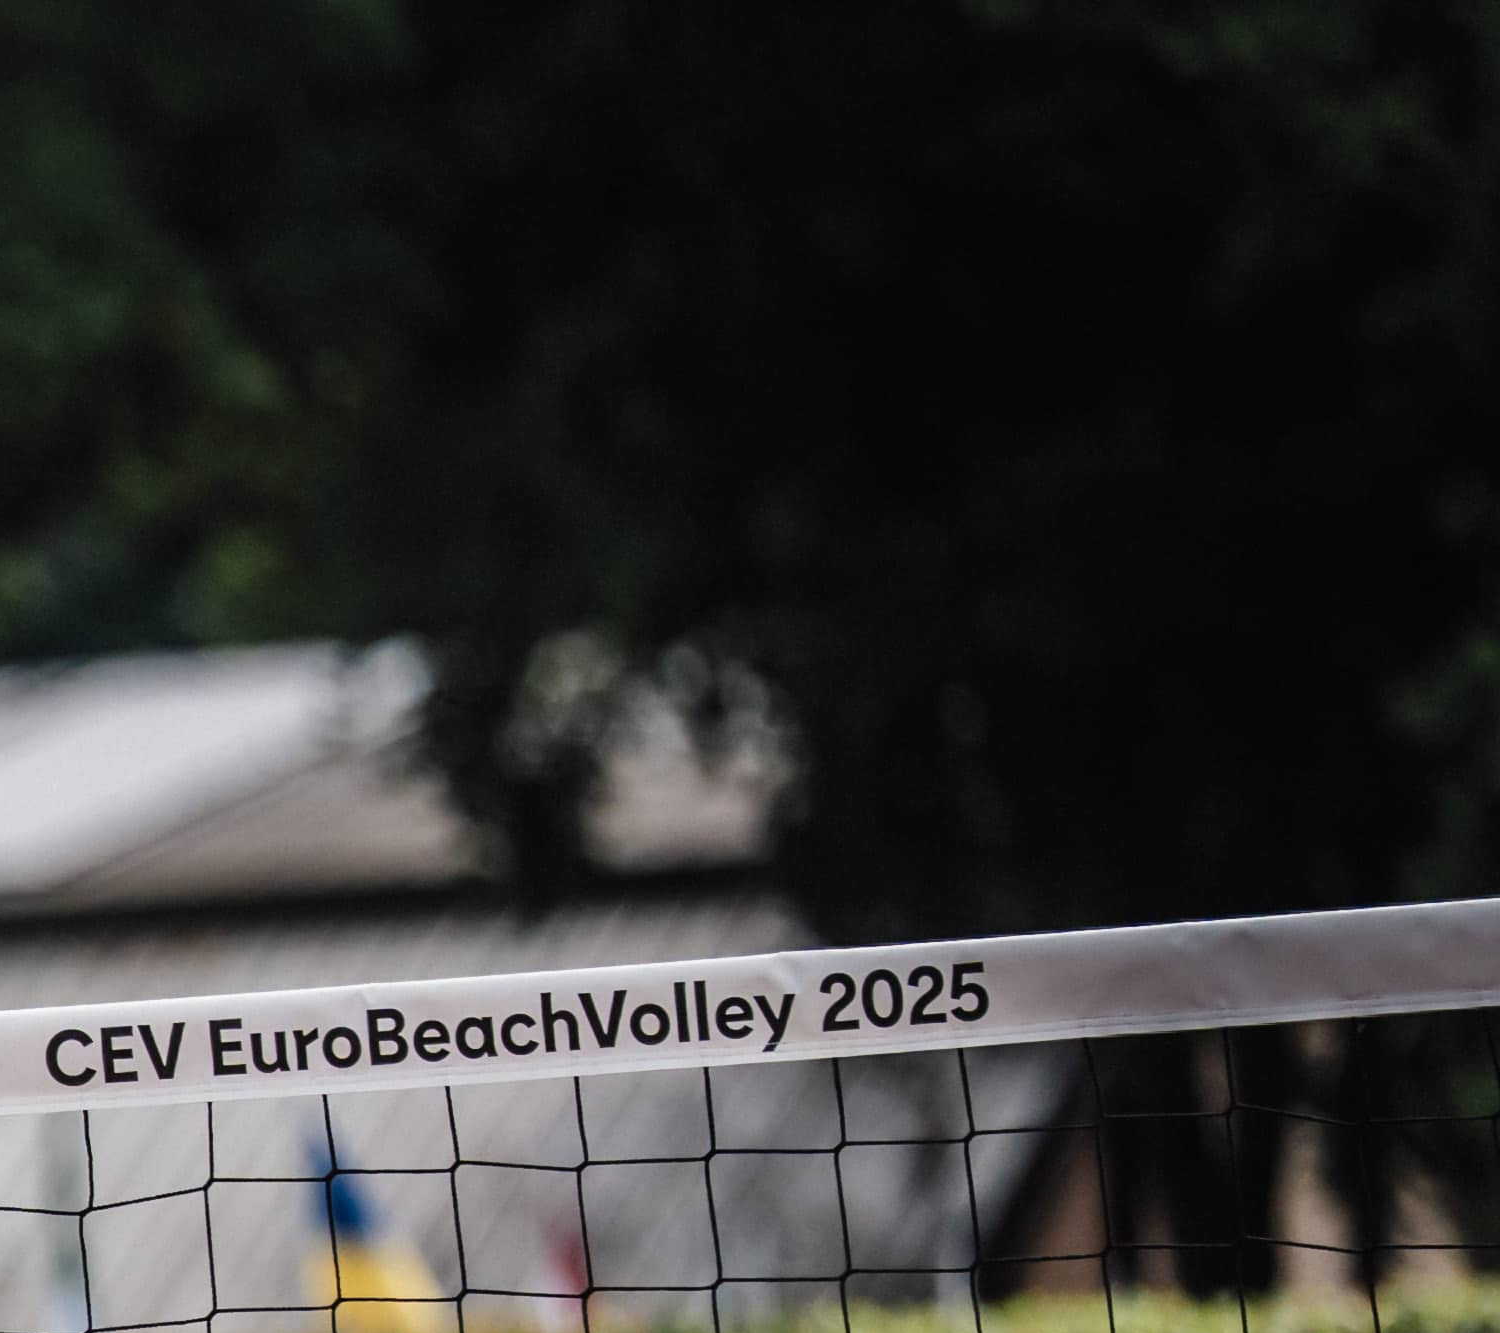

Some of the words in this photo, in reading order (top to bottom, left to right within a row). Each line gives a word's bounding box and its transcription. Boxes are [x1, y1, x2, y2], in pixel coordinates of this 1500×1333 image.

[44, 1021, 186, 1087] CEV
[211, 980, 797, 1077] EuroBeachVolley
[819, 961, 991, 1032] 2025
